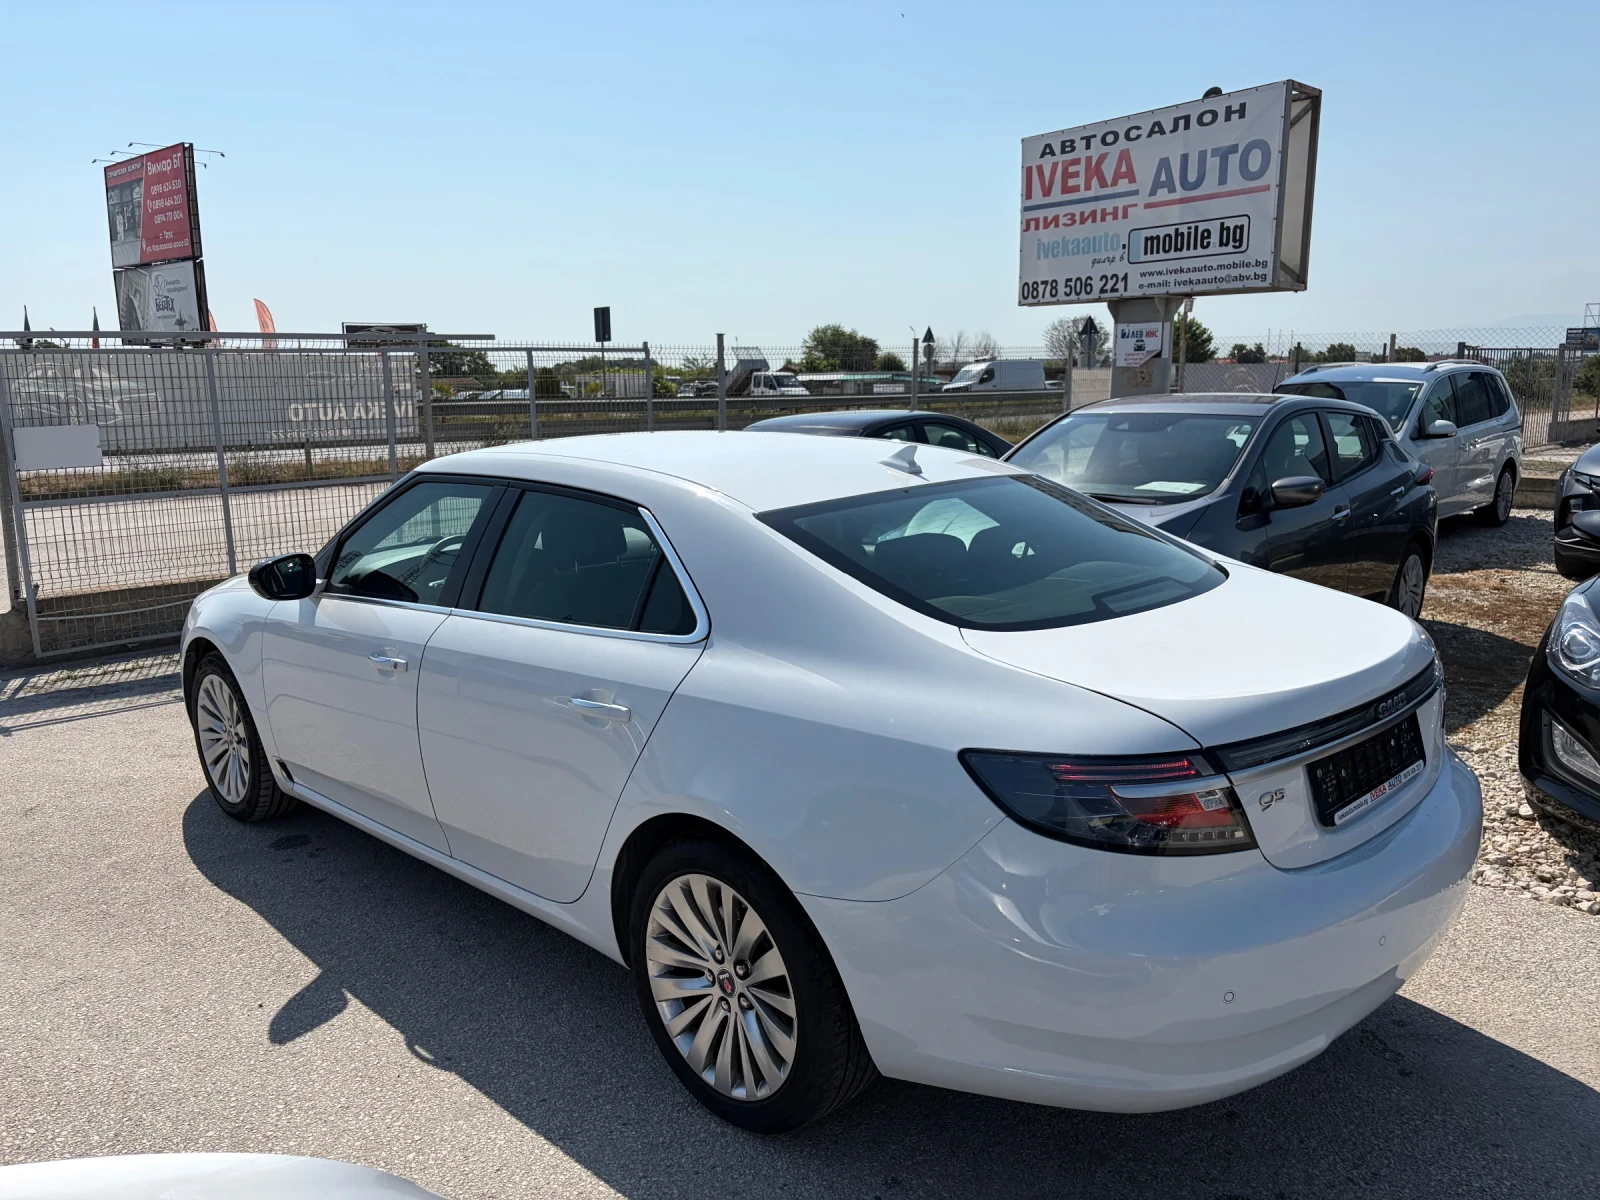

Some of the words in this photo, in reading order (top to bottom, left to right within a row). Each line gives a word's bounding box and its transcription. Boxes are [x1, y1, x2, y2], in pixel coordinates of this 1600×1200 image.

[1039, 102, 1247, 159] АВТОСАЛОН
[147, 158, 172, 176] Вимар
[172, 153, 181, 169] БГ
[1024, 148, 1137, 200] IVEKA
[1148, 138, 1271, 197] AUTO
[1023, 203, 1138, 232] ЛИЗИНГ
[1143, 220, 1245, 256] mobile.bg
[1091, 253, 1117, 268] дилър
[1139, 258, 1268, 278] www.ivekaauto.mobile.bg
[1022, 279, 1058, 300] 0878
[1063, 276, 1094, 298] 506
[1099, 272, 1129, 294] 221
[1138, 280, 1171, 290] e-mail:
[1173, 271, 1267, 288] ivekaauto@abv.bg
[1370, 785, 1387, 800] IVEKA
[1388, 775, 1403, 789] AUTO
